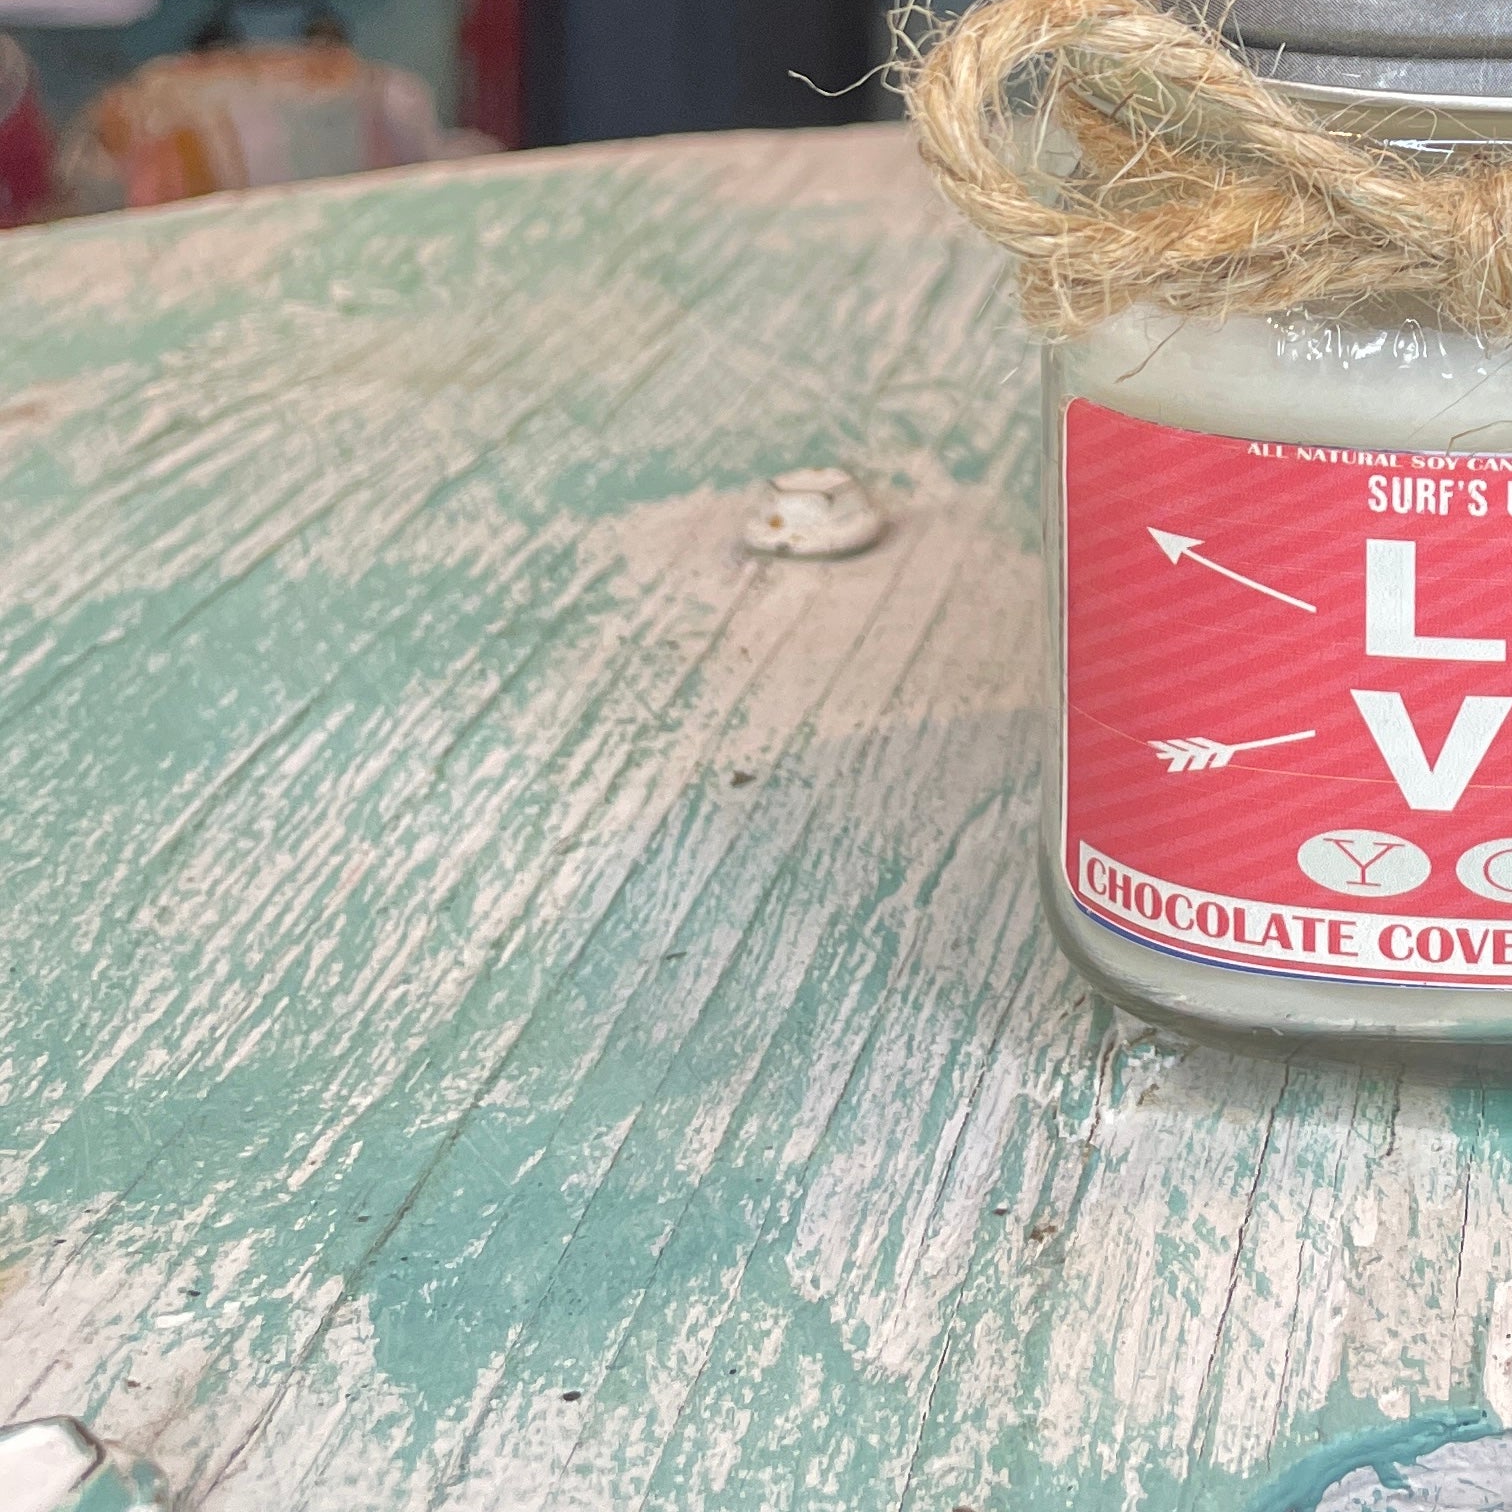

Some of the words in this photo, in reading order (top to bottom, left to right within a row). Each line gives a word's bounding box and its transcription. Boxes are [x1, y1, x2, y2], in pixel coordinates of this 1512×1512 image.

[1247, 441, 1289, 459] ALL
[1296, 446, 1403, 468] NATURAL
[1411, 455, 1459, 470] SOY
[1367, 474, 1489, 517] SURF'S
[1086, 856, 1359, 957] CHOCOLATE
